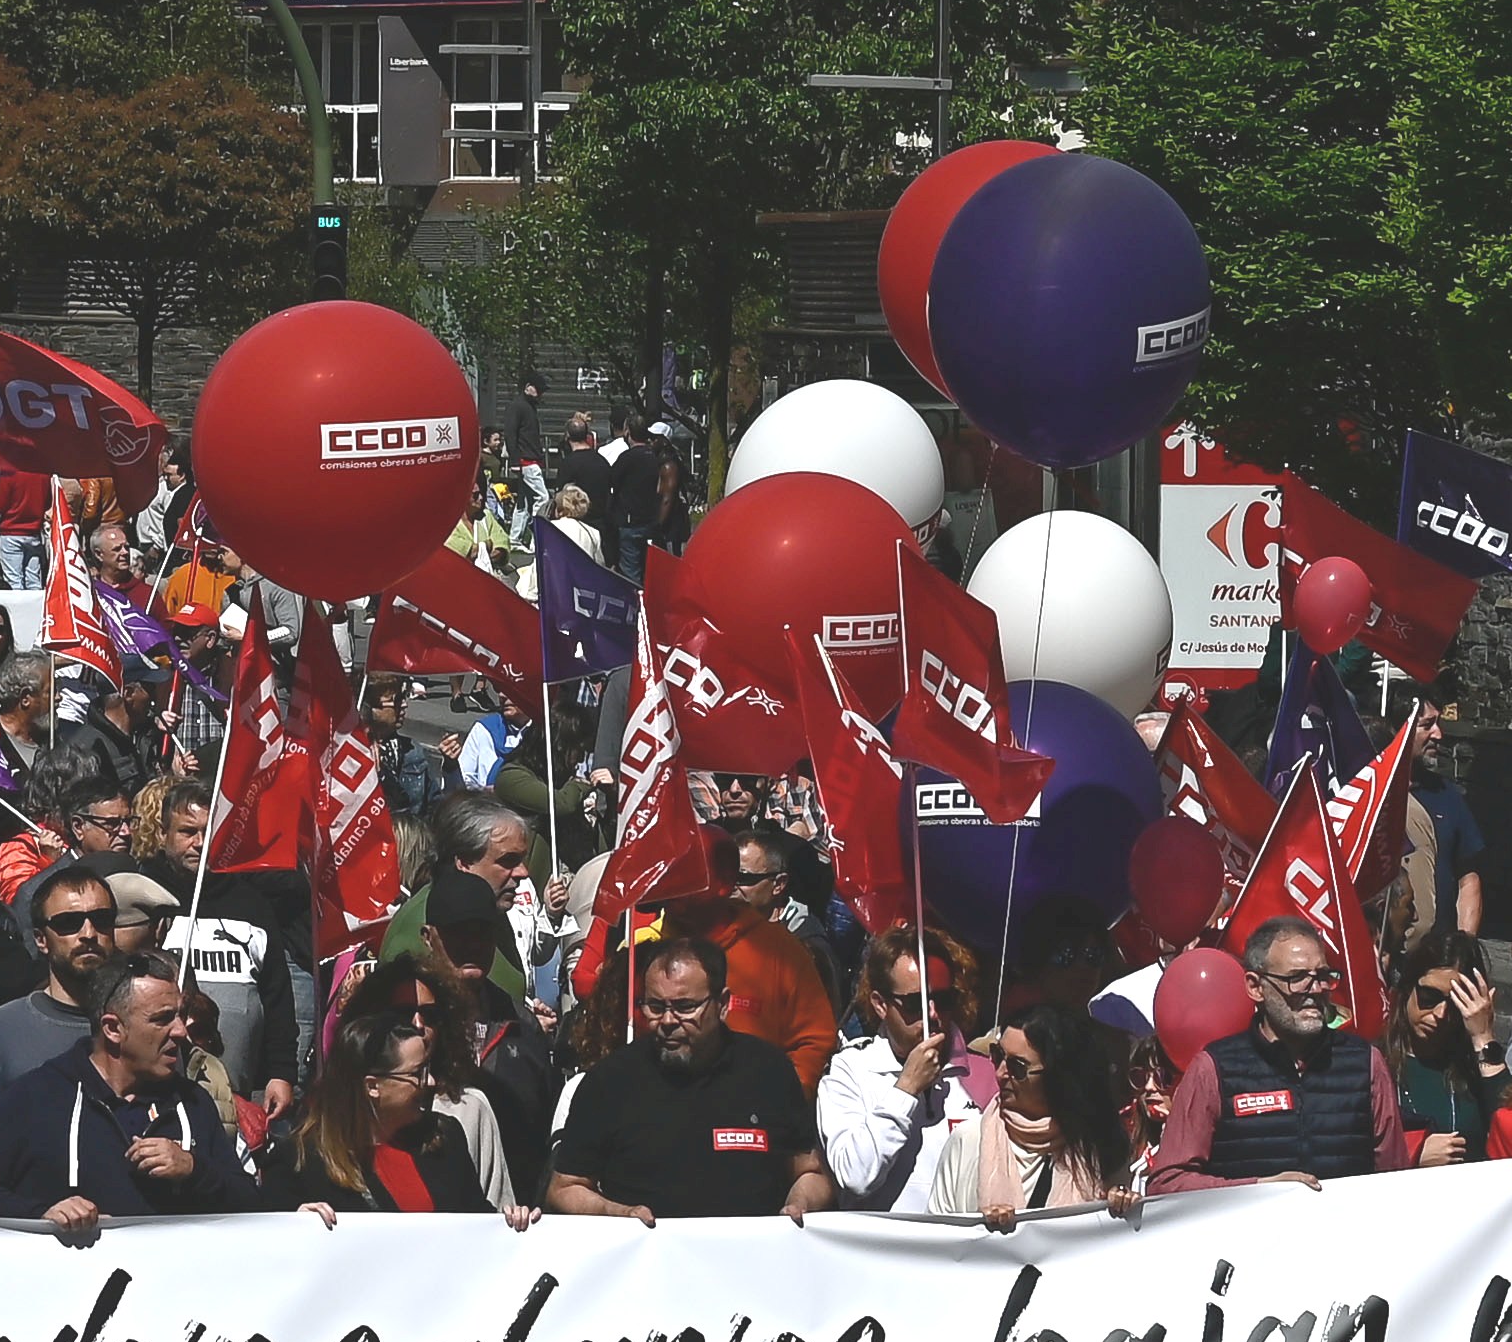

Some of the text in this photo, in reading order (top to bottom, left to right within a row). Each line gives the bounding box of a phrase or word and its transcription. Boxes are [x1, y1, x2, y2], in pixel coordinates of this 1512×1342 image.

[318, 217, 341, 228] BUS
[329, 425, 427, 452] CCOO
[320, 461, 378, 470] comisiones
[380, 459, 415, 468] obreras
[417, 457, 427, 465] de
[1417, 501, 1510, 557] CCOO
[1211, 579, 1281, 603] mark
[1180, 642, 1193, 654] C/
[1196, 640, 1223, 654] Jesús
[1225, 641, 1238, 653] de
[919, 790, 973, 810] CCO
[193, 948, 242, 973] UMA
[1237, 1096, 1275, 1109] CCOO
[717, 1132, 754, 1143] CCOO
